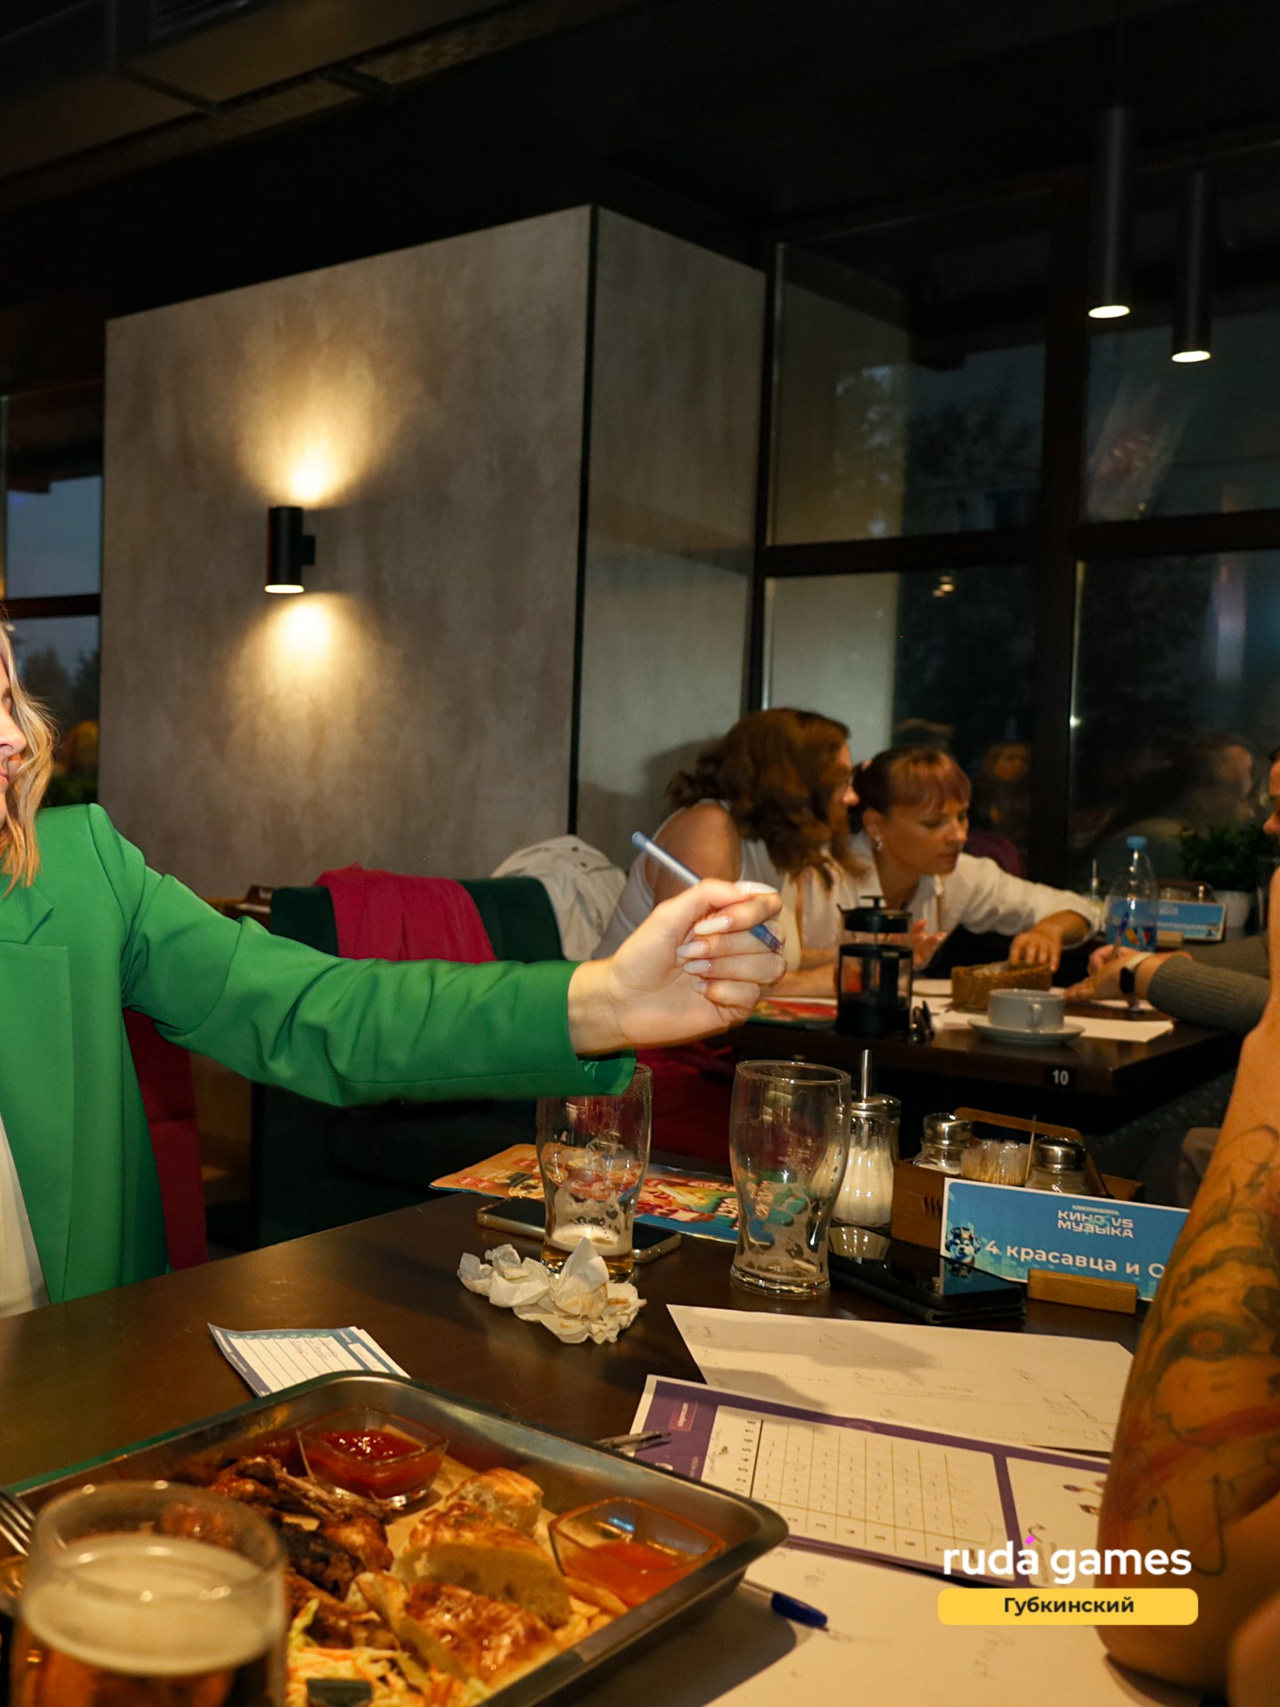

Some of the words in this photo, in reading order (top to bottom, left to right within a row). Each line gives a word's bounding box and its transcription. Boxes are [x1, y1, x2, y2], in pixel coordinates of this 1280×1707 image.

[1052, 1069, 1069, 1086] 10
[1057, 1220, 1134, 1239] МУЗЫКА
[1110, 1216, 1134, 1229] VS
[985, 1239, 1000, 1255] 4
[1007, 1245, 1118, 1273] красавца
[1126, 1261, 1141, 1276] и
